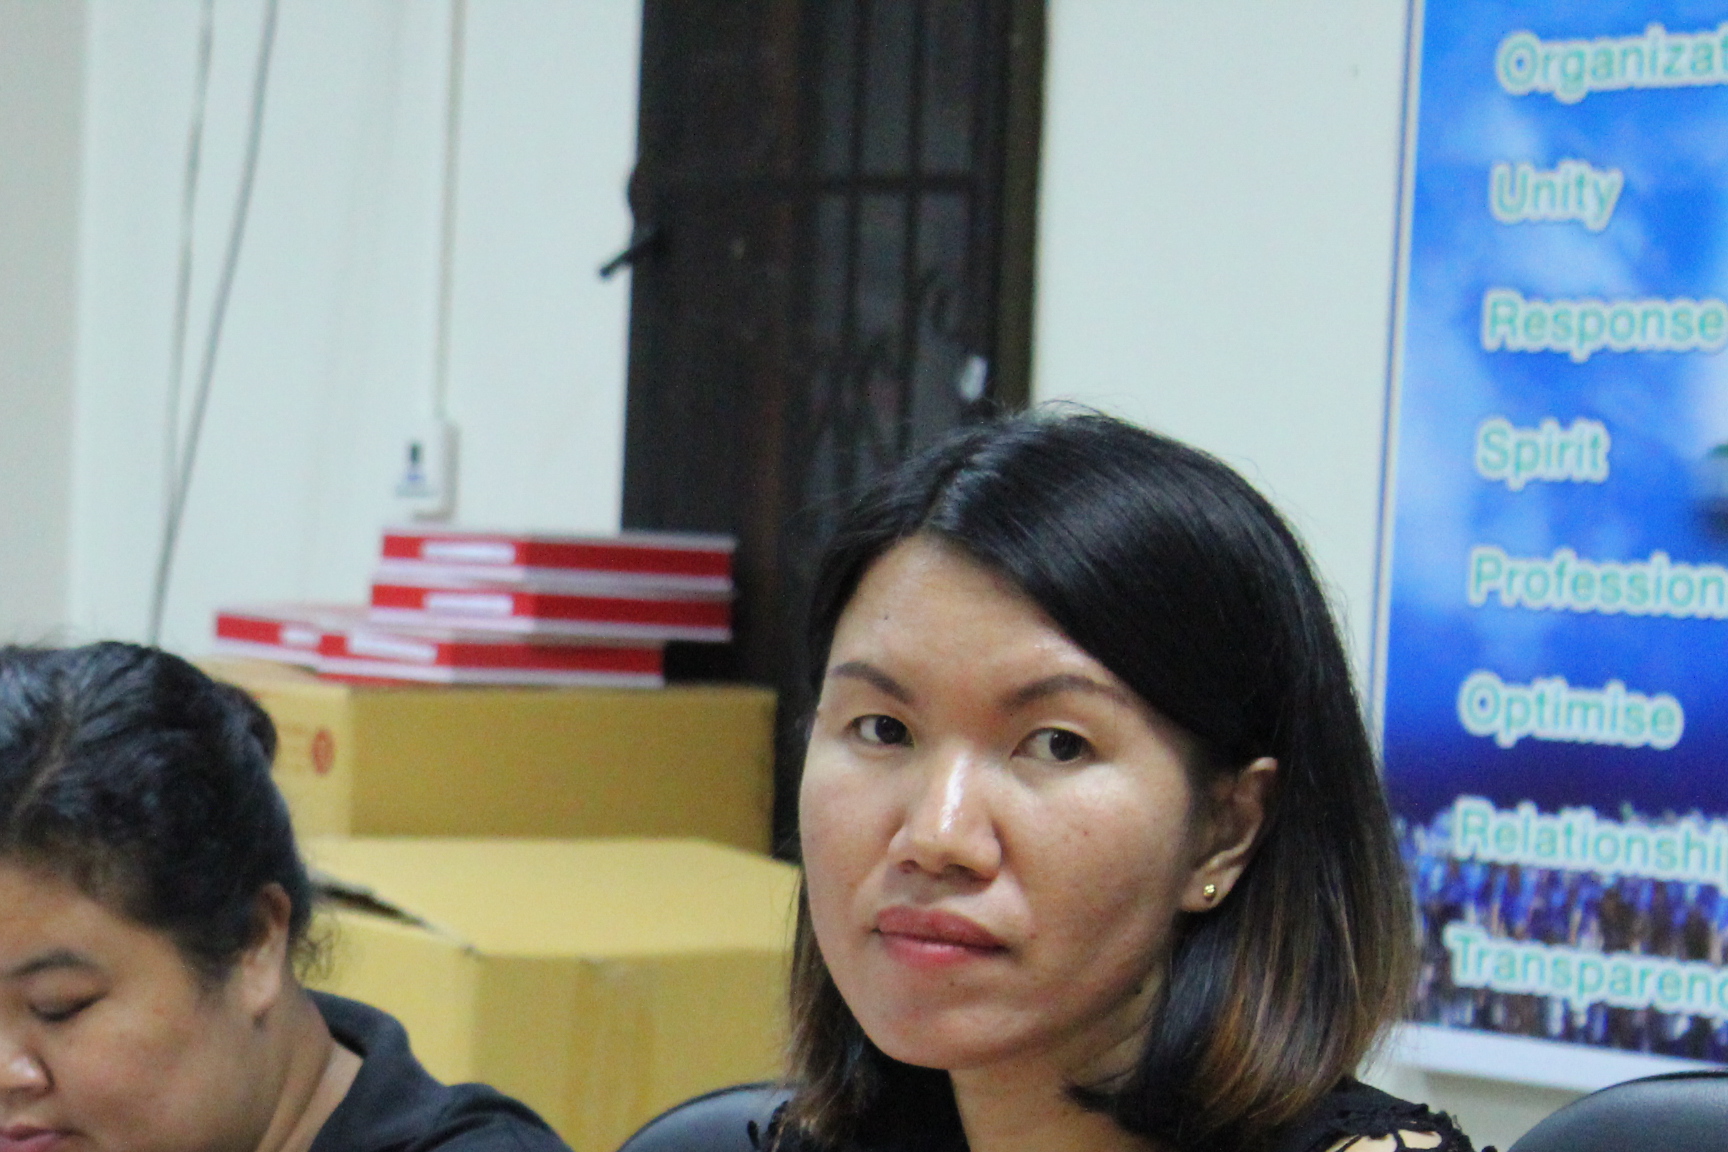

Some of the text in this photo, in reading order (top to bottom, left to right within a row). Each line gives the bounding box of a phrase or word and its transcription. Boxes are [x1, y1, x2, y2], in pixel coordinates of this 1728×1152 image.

[1490, 160, 1622, 231] Unity
[1483, 288, 1728, 362] Response
[1477, 418, 1610, 490] Spirit
[1468, 547, 1728, 618] Profession
[1459, 672, 1683, 748] Optimise
[1453, 797, 1728, 888] Relationshi
